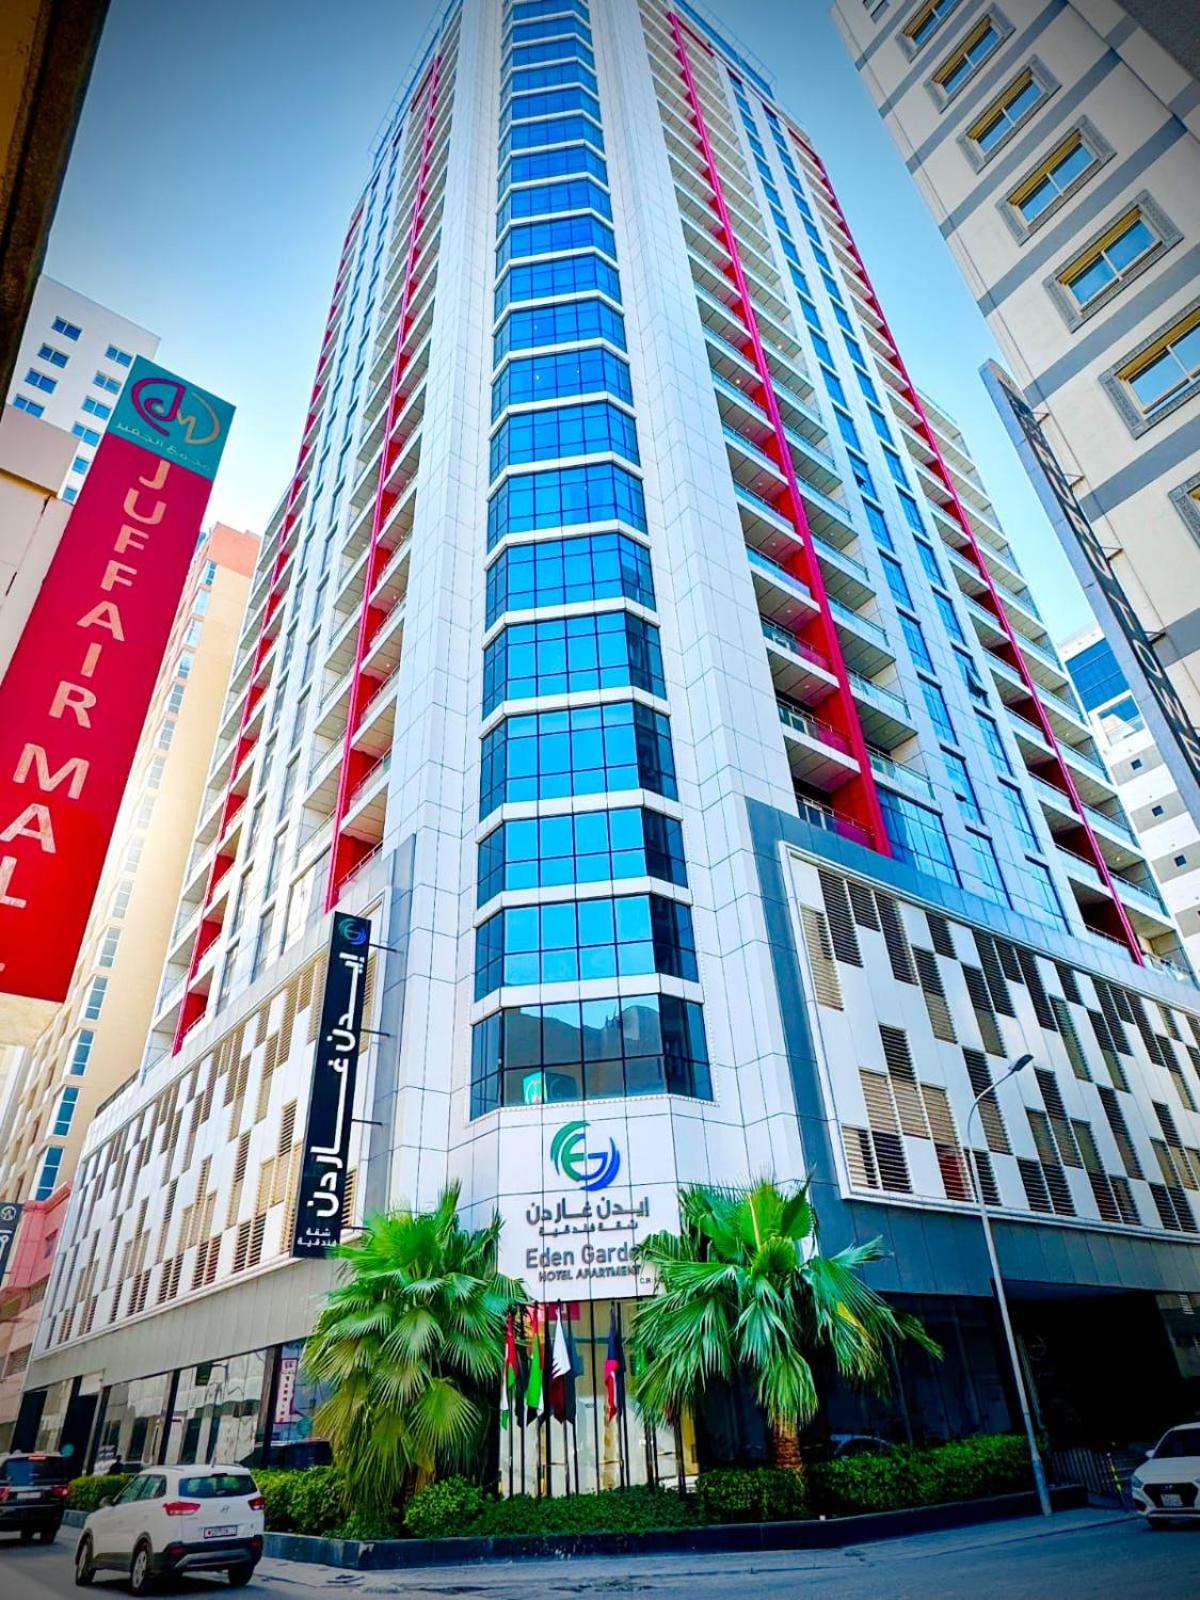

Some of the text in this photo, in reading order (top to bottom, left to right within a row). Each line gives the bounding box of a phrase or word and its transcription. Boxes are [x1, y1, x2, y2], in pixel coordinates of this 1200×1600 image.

[0, 459, 171, 972] JUFFAIR MAL
[1107, 591, 1200, 772] TOWE
[525, 1241, 641, 1269] Eden Garde
[539, 1269, 573, 1283] HOTEL
